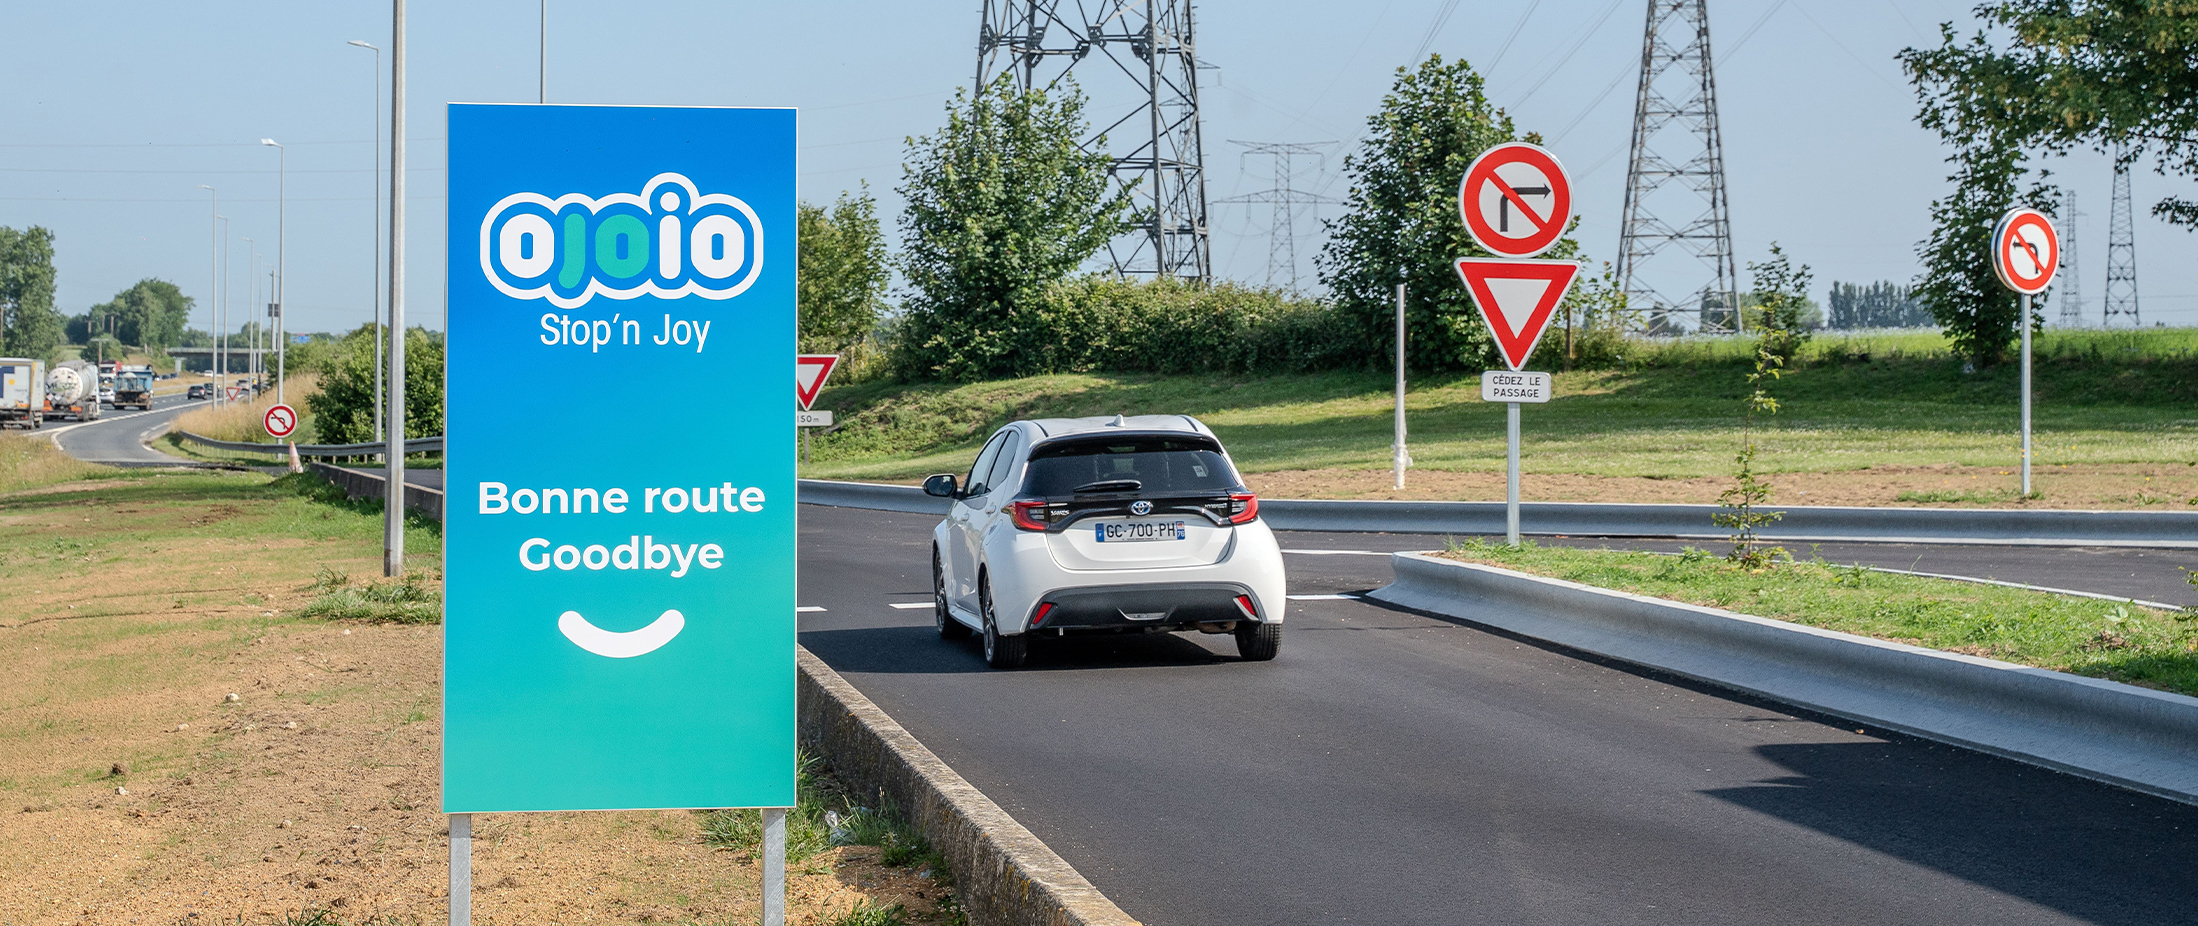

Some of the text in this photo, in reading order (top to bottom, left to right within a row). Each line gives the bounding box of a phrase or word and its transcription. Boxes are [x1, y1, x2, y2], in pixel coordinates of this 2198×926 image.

[499, 191, 745, 289] ojoio
[653, 313, 711, 354] Joy
[1492, 374, 1541, 386] CÉDEZ LE
[1493, 388, 1539, 398] PASSAGE
[479, 481, 766, 515] Bonne route
[1106, 523, 1176, 538] GC-700-PH
[1177, 530, 1185, 538] 76
[519, 535, 724, 578] Goodbye
